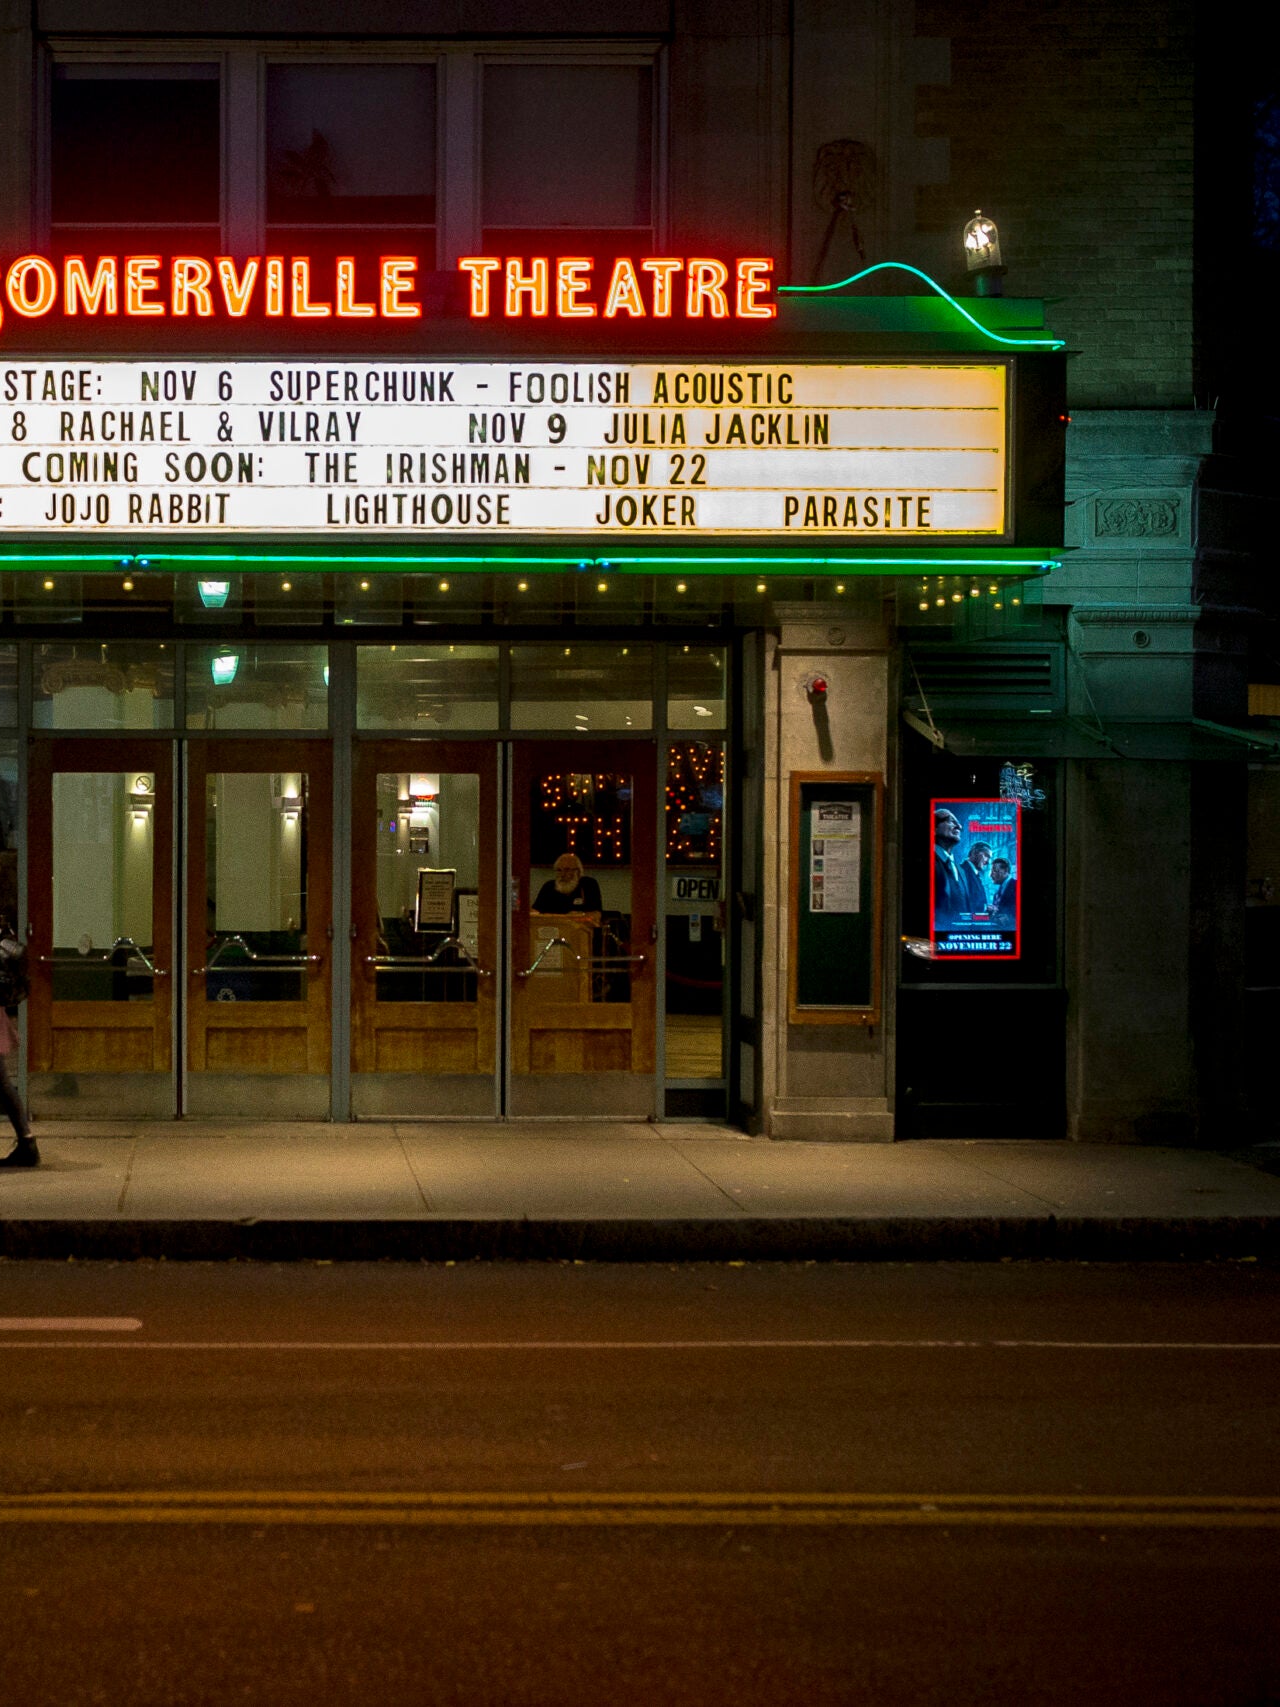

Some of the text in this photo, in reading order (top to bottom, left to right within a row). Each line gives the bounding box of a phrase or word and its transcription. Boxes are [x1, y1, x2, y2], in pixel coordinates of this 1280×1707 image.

[459, 257, 777, 319] THEATRE
[4, 371, 102, 401] STAGE:
[141, 371, 197, 402] NOV
[218, 371, 233, 402] 6
[270, 372, 455, 403] SUPERCHUNK
[509, 373, 629, 404] FOOLISH
[653, 374, 793, 405] ACOUSTIC
[11, 412, 27, 442] 8
[60, 412, 190, 442] RACHAEL
[217, 413, 233, 442] &
[258, 412, 361, 443] VILRAY
[469, 414, 526, 444] NOV
[547, 414, 567, 444] 9
[604, 414, 686, 445] JULIA
[705, 415, 829, 446] JACKLIN
[22, 453, 138, 483] COMING
[165, 453, 264, 483] SOON:
[304, 454, 358, 483] THE
[386, 454, 530, 484] IRISHMAN
[587, 455, 650, 486] NOV
[669, 455, 706, 485] 22
[45, 494, 109, 524] JOJO
[129, 494, 230, 524] RABBIT
[327, 494, 510, 526] LIGHTHOUSE
[596, 495, 695, 527] JOKER
[784, 497, 930, 528] PARASITE
[677, 879, 719, 899] OPEN
[937, 941, 1013, 951] NOVEMBER 22
